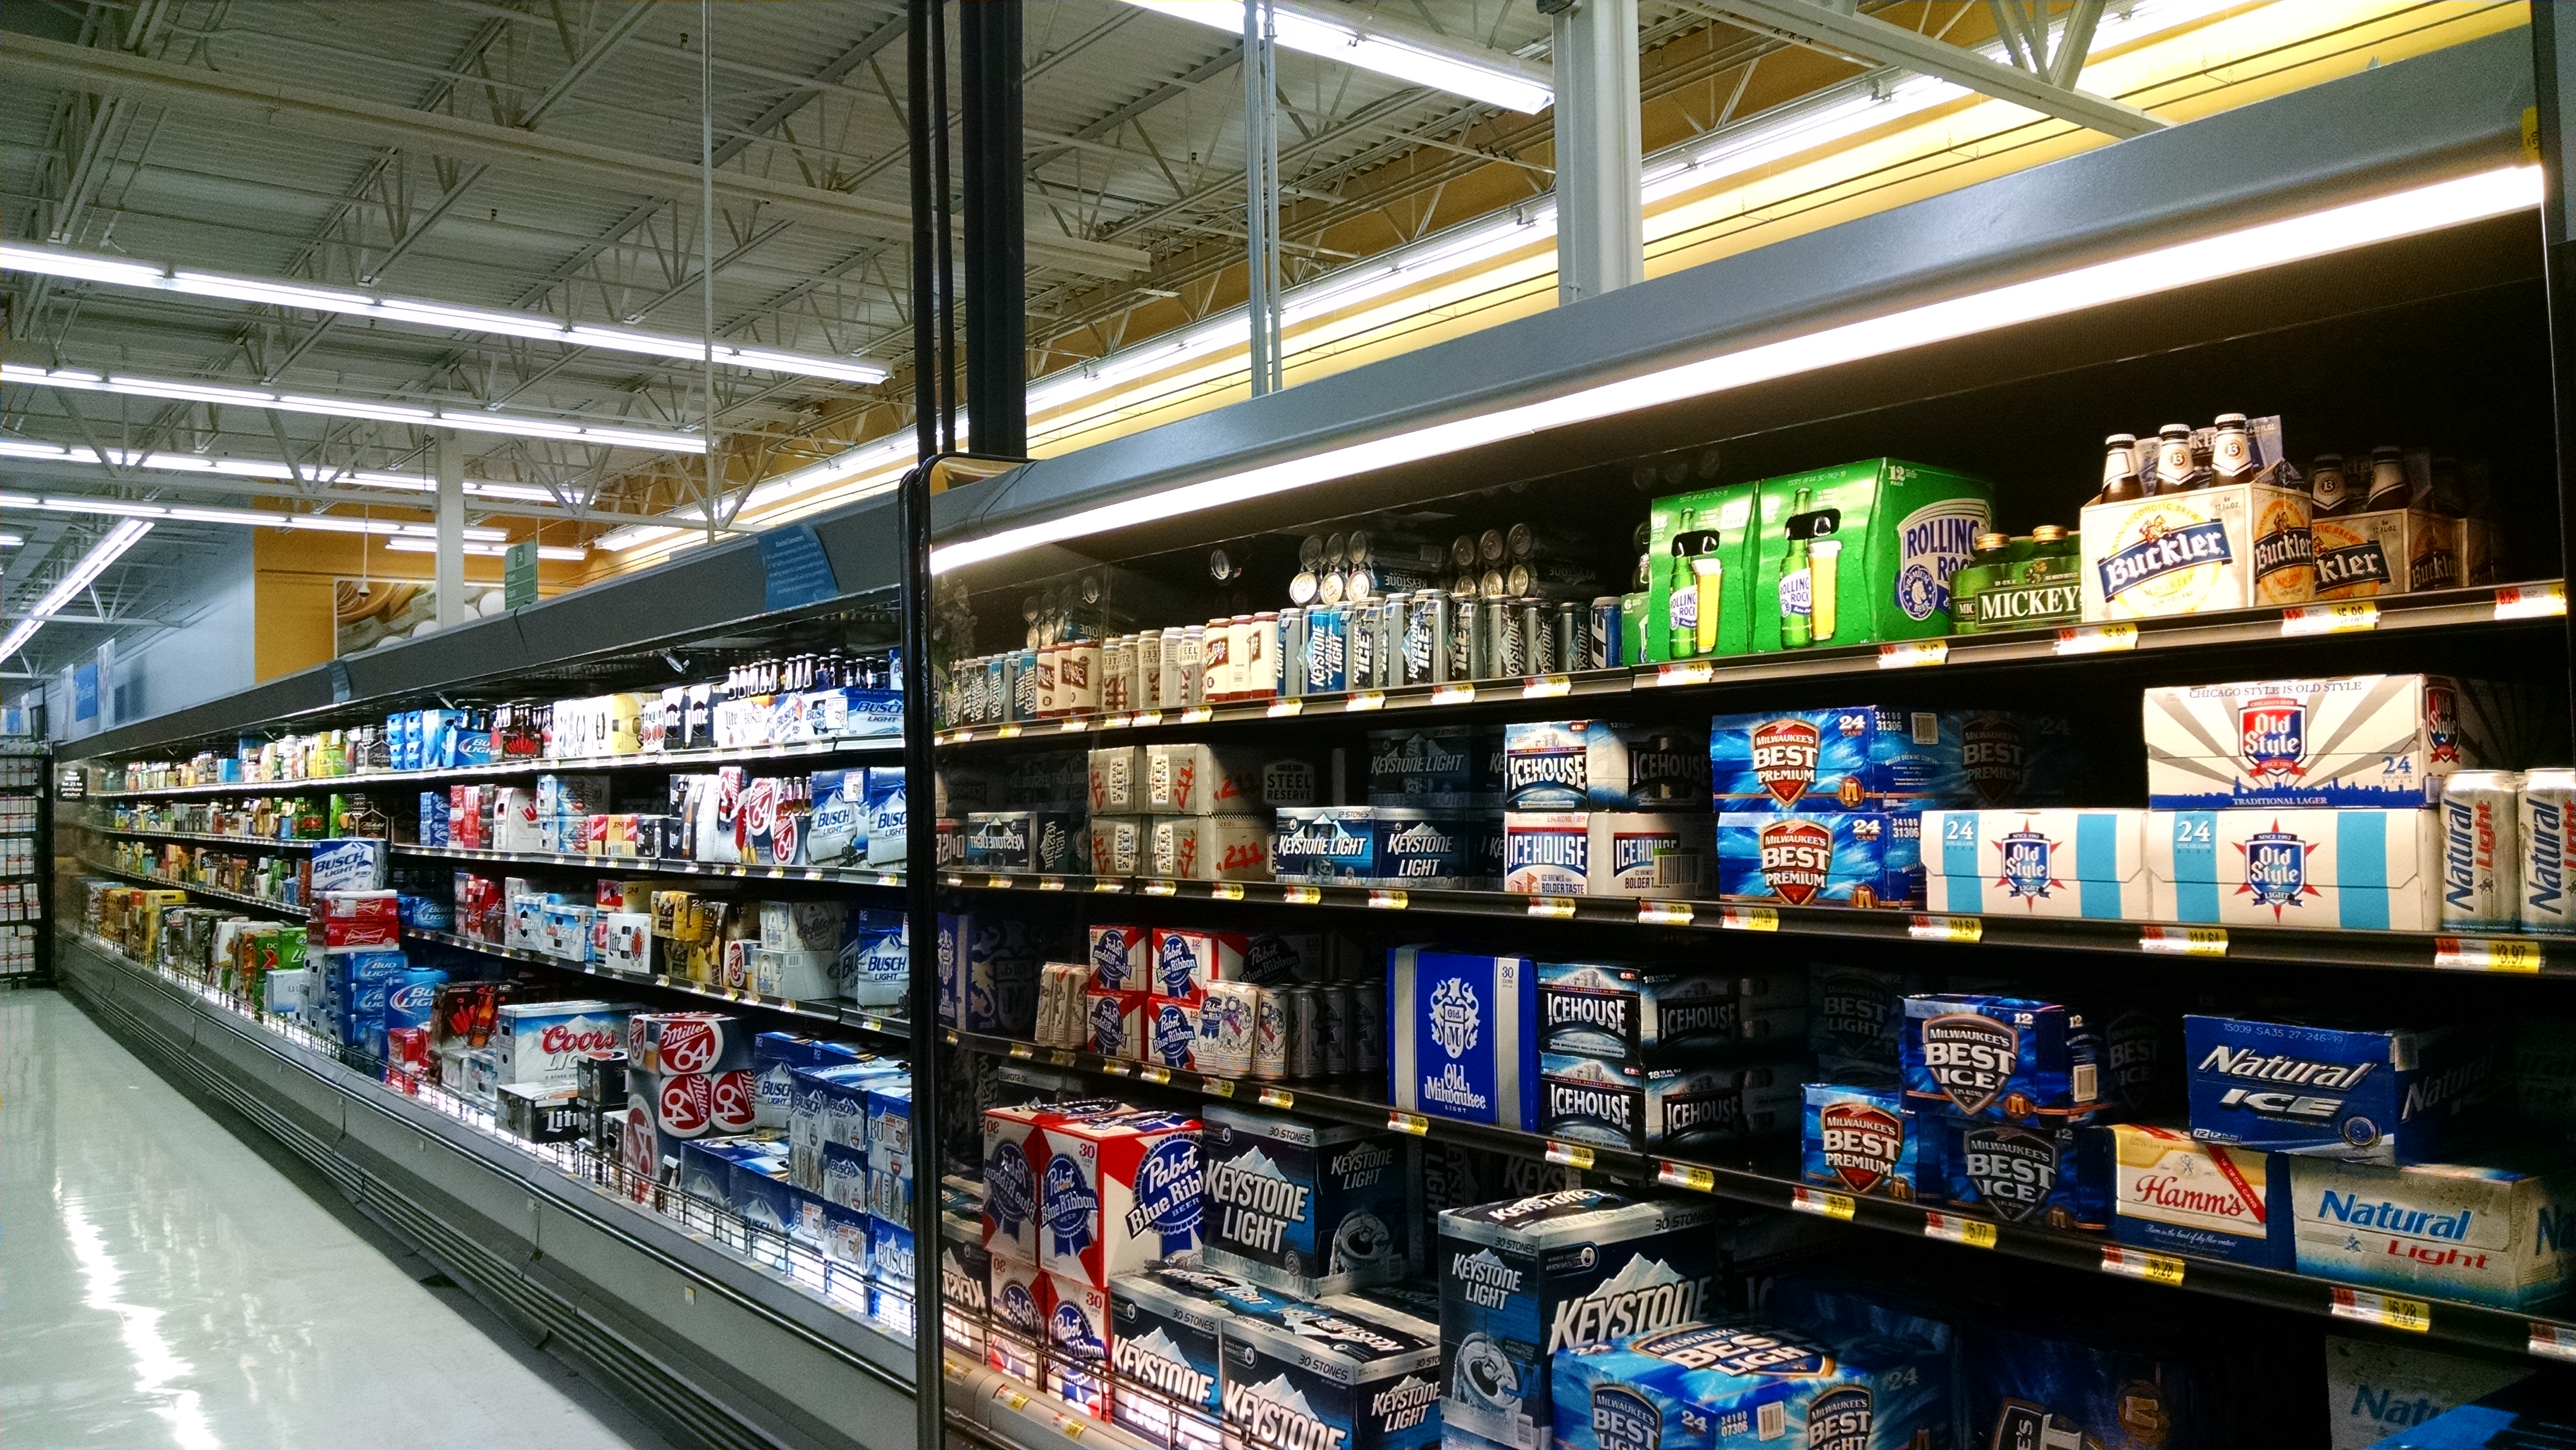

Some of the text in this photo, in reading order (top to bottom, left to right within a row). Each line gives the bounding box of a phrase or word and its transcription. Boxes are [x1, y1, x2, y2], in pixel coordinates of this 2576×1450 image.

[1888, 465, 1905, 481] 12
[2106, 531, 2222, 593] Buckler
[1781, 577, 1809, 595] ROLLING
[1791, 591, 1809, 602] ROCK
[1624, 599, 1631, 609] 6
[1671, 593, 1696, 609] ROLLING
[1679, 606, 1696, 615] ROCK
[2189, 681, 2362, 699] CHICAGO STYLE IS OLD STYLE
[1839, 715, 1866, 730] 24
[1875, 711, 1902, 720] 34100
[1876, 720, 1902, 731] 31306
[2254, 712, 2291, 735] Old
[1756, 734, 1814, 746] MILWAUKEE'S
[2244, 731, 2300, 755] Style
[1753, 745, 1818, 770] BEST
[1963, 742, 2024, 766] BEST
[2382, 755, 2413, 775] 24
[1155, 756, 1163, 800] STEEL
[1267, 774, 1311, 789] STEEL
[1510, 754, 1586, 791] ICEHOUSE
[1757, 769, 1815, 785] PREMIUM
[1267, 789, 1311, 800] RESERVE
[2232, 797, 2328, 806] TRADITIONAL LAGER
[818, 808, 850, 828] BUSCH
[1853, 819, 1881, 835] 24
[1892, 818, 1919, 826] 34100
[822, 826, 843, 835] LIGHT
[1765, 834, 1826, 847] MILWAUKEE'S
[1893, 827, 1921, 839] 31306
[1946, 820, 1974, 841] 24
[2177, 820, 2211, 843] 24
[2475, 800, 2496, 869] Light
[1278, 836, 1366, 856] KEYSTONE LIGHT
[1387, 833, 1453, 854] KEYSTONE
[1510, 835, 1586, 870] ICEHOUSE
[2012, 842, 2038, 861] Old
[313, 850, 364, 873] BUSCH
[1761, 847, 1831, 870] BEST
[2259, 845, 2292, 866] Old
[2444, 798, 2474, 912] Natural
[2525, 797, 2563, 916] Natural
[324, 866, 354, 878] LIGHT
[1398, 859, 1440, 877] LIGHT
[2006, 856, 2046, 881] Style
[2251, 861, 2299, 889] Style
[1541, 883, 1584, 894] BOLDER TASTE
[1765, 872, 1826, 888] PREMIUM
[2264, 891, 2290, 900] LIGHT
[1162, 943, 1182, 962] Pabst
[1191, 939, 1201, 947] 12
[2496, 943, 2526, 965] $3.97
[868, 956, 907, 971] BUSCH
[1502, 966, 1514, 978] 30
[874, 972, 898, 981] LIGHT
[1643, 975, 1655, 984] 18
[1160, 1013, 1180, 1033] Pabst
[1547, 993, 1627, 1037] ICEHOUSE
[2014, 1013, 2034, 1025] 12
[2069, 1015, 2083, 1028] 12
[541, 1024, 618, 1055] Coors
[661, 1023, 710, 1046] Miller
[1929, 1028, 2010, 1048] MILWAUKEE'S
[2256, 1027, 2284, 1038] SA35
[673, 1037, 711, 1071] 64
[1924, 1042, 2016, 1075] BEST
[1444, 1063, 1466, 1090] Old
[1648, 1071, 1659, 1080] 18
[1940, 1067, 1996, 1090] ICE
[2197, 1045, 2377, 1090] Natural
[794, 1093, 822, 1115] BUSCH
[1425, 1076, 1487, 1110] Milwaukee
[2219, 1088, 2344, 1117] ICE
[1445, 1105, 1467, 1113] LIGHT
[1550, 1083, 1631, 1132] ICEHOUSE
[1269, 1126, 1311, 1144] 30 STONES
[1827, 1116, 1896, 1136] MILWAUKEE'S
[1079, 1143, 1095, 1158] 30
[1823, 1130, 1901, 1161] BEST
[1970, 1139, 2050, 1163] MILWAUKEE'S
[1142, 1145, 1200, 1194] Pabst
[1825, 1152, 1893, 1178] PREMIUM
[1966, 1153, 2057, 1190] BEST
[1204, 1158, 1309, 1222] KEYSTONE
[1980, 1179, 2039, 1203] ICE
[2133, 1175, 2247, 1217] Hamm's
[1171, 1197, 1201, 1217] BEER
[2318, 1189, 2474, 1241] Natural
[1222, 1205, 1288, 1254] LIGHT
[1654, 1210, 1714, 1232] 30 STONES
[1495, 1237, 1536, 1253] 30 STONES
[2387, 1240, 2493, 1270] Light
[1452, 1253, 1523, 1293] KEYSTONE
[2150, 1258, 2174, 1278] $6.28
[1085, 1291, 1103, 1309] 30
[1465, 1281, 1509, 1310] LIGHT
[1172, 1308, 1216, 1331] 30 STONES
[1547, 1275, 1713, 1356] KEYSTONE
[2388, 1300, 2418, 1325] $6.28
[1112, 1334, 1214, 1411] KEYSTONE
[1298, 1354, 1348, 1380] 30 STONES
[1371, 1381, 1441, 1417] KEYSTONE
[1384, 1404, 1431, 1434] LIGHT
[1592, 1406, 1659, 1450] BEST
[1681, 1409, 1708, 1431] 24
[1808, 1411, 1872, 1439] BEST
